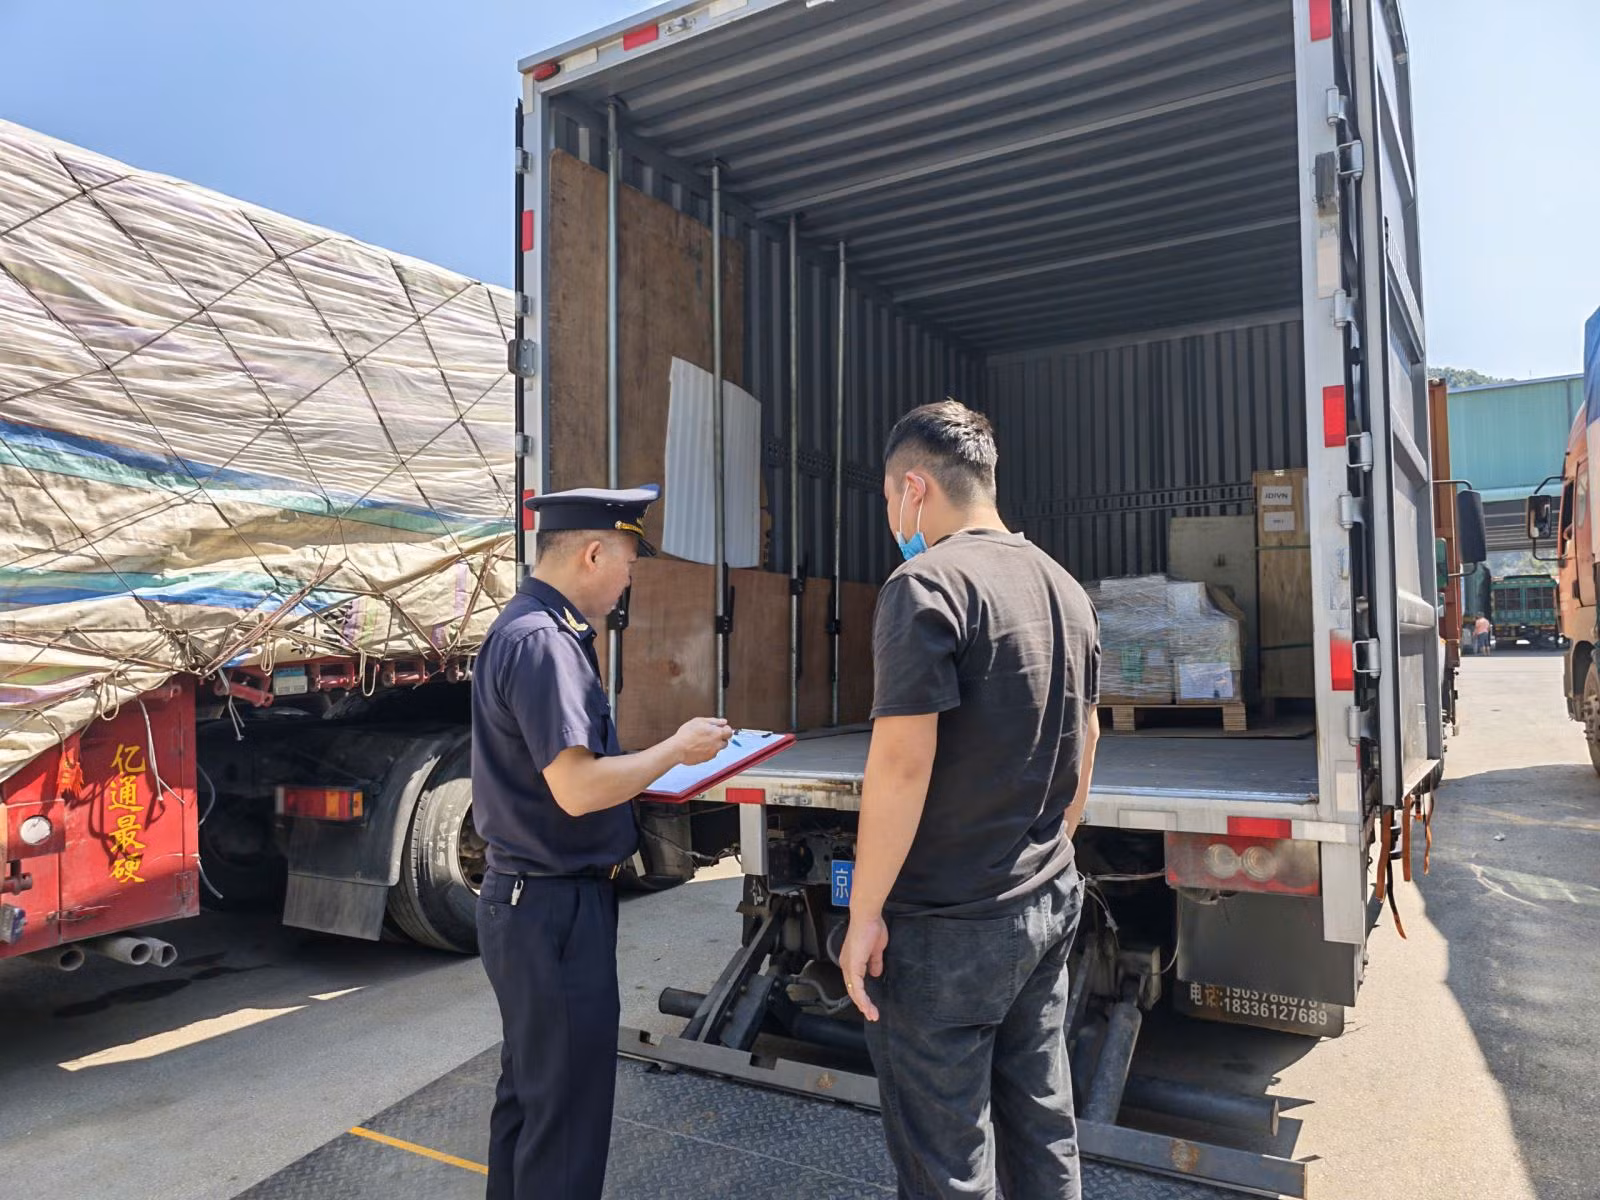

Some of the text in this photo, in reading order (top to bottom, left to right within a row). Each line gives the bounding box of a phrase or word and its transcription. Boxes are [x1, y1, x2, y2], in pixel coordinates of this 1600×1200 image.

[108, 743, 147, 883] 亿通最硬
[835, 868, 849, 899] 京
[1224, 997, 1328, 1026] 18336127689
